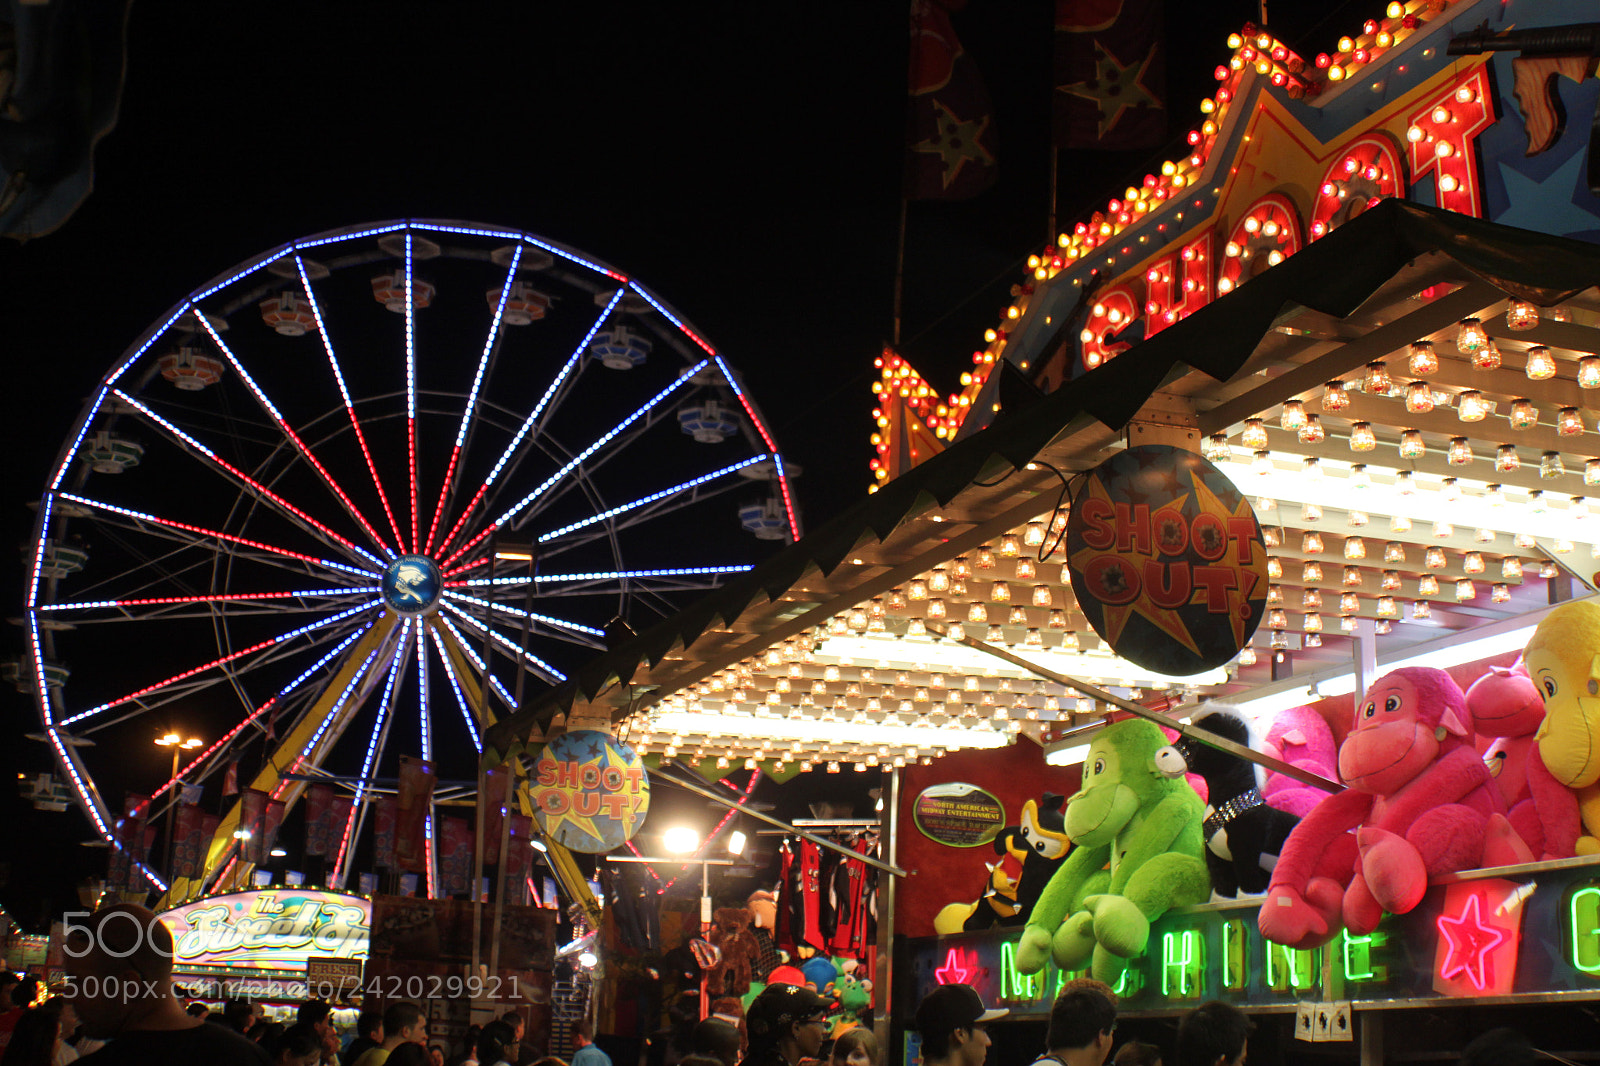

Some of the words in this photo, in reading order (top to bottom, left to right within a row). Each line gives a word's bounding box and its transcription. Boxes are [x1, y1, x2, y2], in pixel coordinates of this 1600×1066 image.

[1081, 497, 1257, 564] SHOOT
[1083, 554, 1259, 620] OUT!
[536, 759, 643, 794] SHOOT
[536, 787, 642, 824] OUT!
[921, 807, 946, 815] MIDWAY
[946, 810, 1000, 820] ENTERTAINMENT
[932, 801, 955, 809] NORTH
[955, 803, 990, 812] AMERICAN
[257, 895, 285, 914] The
[175, 900, 324, 959] Sweet
[311, 963, 357, 975] FRESH
[227, 981, 284, 998] Candy
